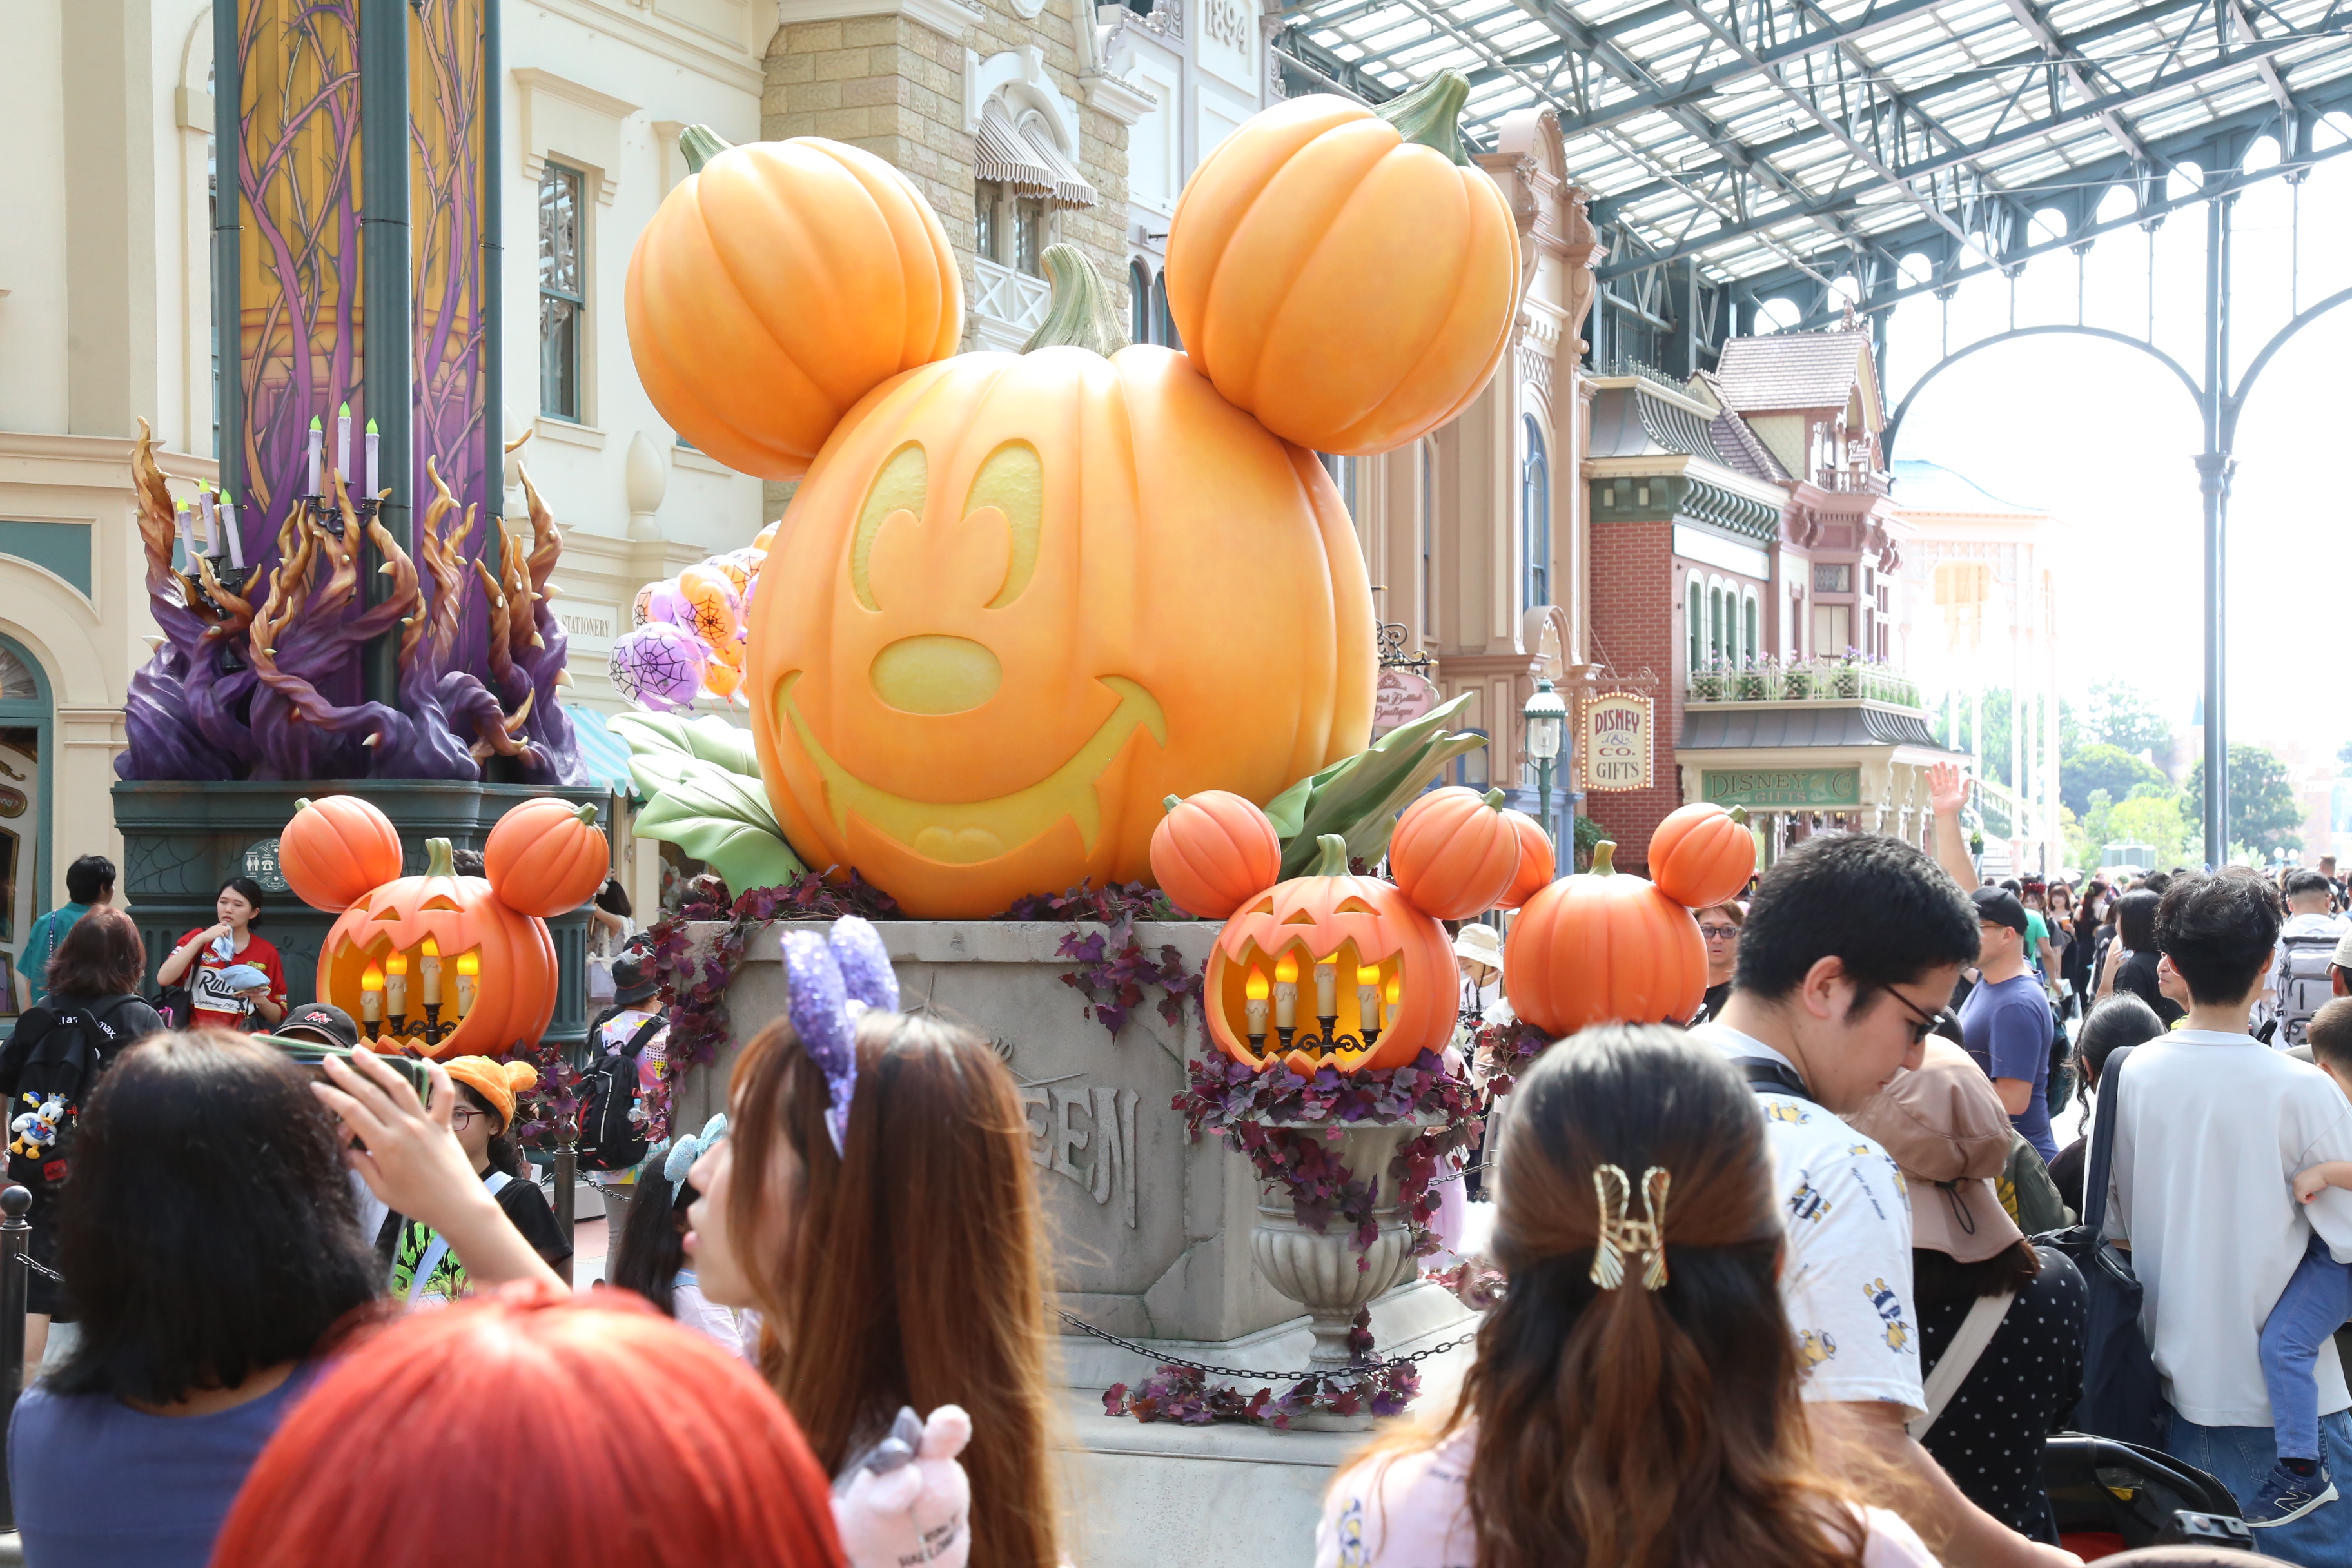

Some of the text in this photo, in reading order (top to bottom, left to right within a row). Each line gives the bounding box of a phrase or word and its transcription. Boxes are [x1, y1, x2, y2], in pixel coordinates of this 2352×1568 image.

[1204, 0, 1247, 55] 1894
[562, 614, 610, 638] STATIONERY
[1594, 709, 1640, 736] DISNEY
[1596, 761, 1639, 780] GIFTS
[1710, 773, 1808, 799] DISNEY
[1755, 791, 1807, 802] GIFTS
